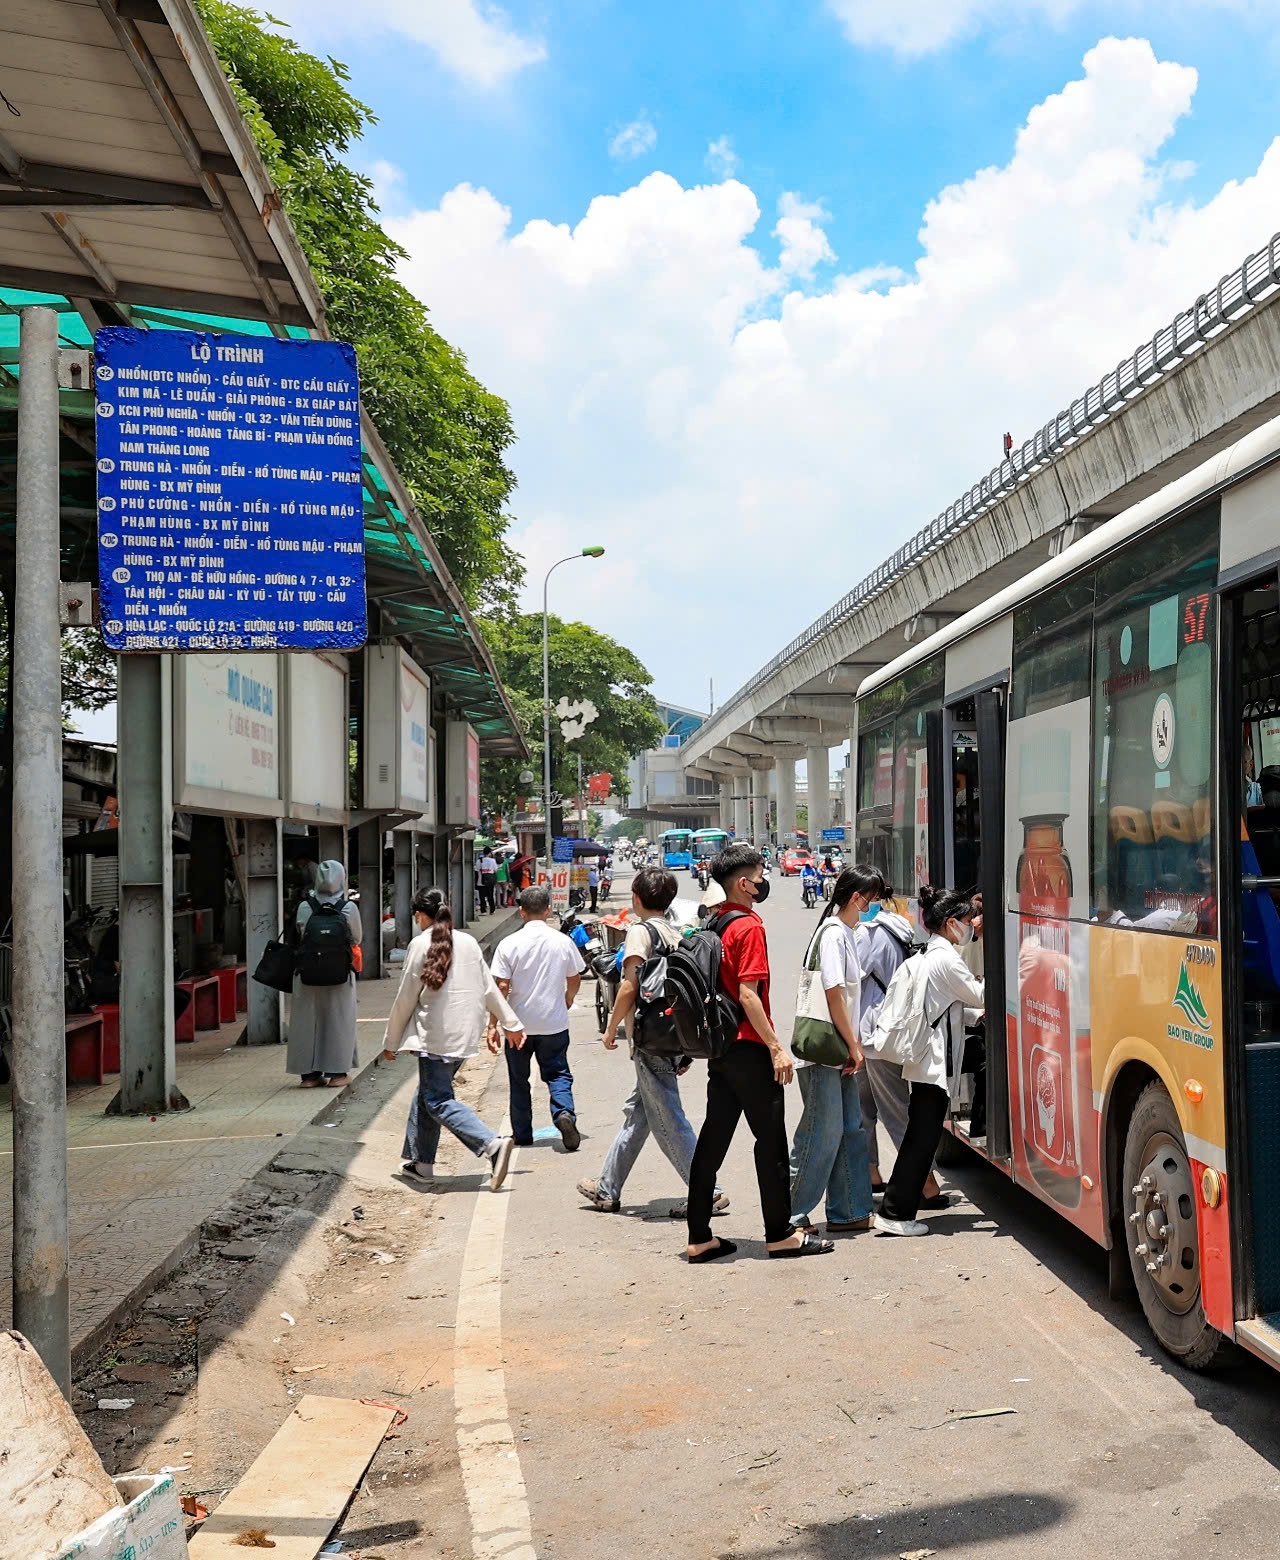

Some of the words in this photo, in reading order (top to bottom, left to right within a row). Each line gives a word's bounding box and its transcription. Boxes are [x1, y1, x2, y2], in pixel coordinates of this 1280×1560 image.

[192, 343, 210, 363] LỘ
[216, 344, 263, 363] TRÌNH
[100, 368, 111, 378] 32
[118, 387, 139, 397] KIM
[171, 388, 182, 400] LÊ
[296, 398, 308, 408] BX
[100, 405, 111, 414] 57
[119, 405, 140, 416] KCN
[245, 413, 257, 423] QL
[260, 413, 272, 424] 32
[119, 421, 139, 434] TÂN
[143, 425, 177, 436] PHONG
[187, 425, 221, 438] HOÀNG
[275, 432, 302, 445] PHẠM
[120, 442, 144, 453] NAM
[184, 445, 209, 456] LONG
[120, 461, 154, 472] TRUNG
[158, 460, 171, 473] HÀ
[301, 468, 322, 483] MẬU
[121, 477, 149, 490] HÙNG
[160, 481, 174, 491] BX
[122, 516, 155, 529] PHẠM
[160, 515, 191, 529] HÙNG
[203, 519, 218, 531] BX
[242, 518, 268, 531] ĐÌNH
[122, 535, 156, 546] TRUNG
[160, 534, 174, 547] HÀ
[303, 539, 324, 553] MẬU
[334, 542, 362, 554] PHẠM
[124, 553, 152, 565] HÙNG
[164, 556, 177, 566] BX
[198, 554, 224, 568] ĐÌNH
[168, 572, 181, 582] AN
[325, 575, 338, 588] QL
[125, 585, 144, 598] TÂN
[277, 589, 294, 601] TÂY
[1184, 593, 1209, 643] 57
[1168, 1024, 1180, 1037] BAO
[1181, 1029, 1192, 1042] YEN
[1193, 1033, 1214, 1049] GROUP
